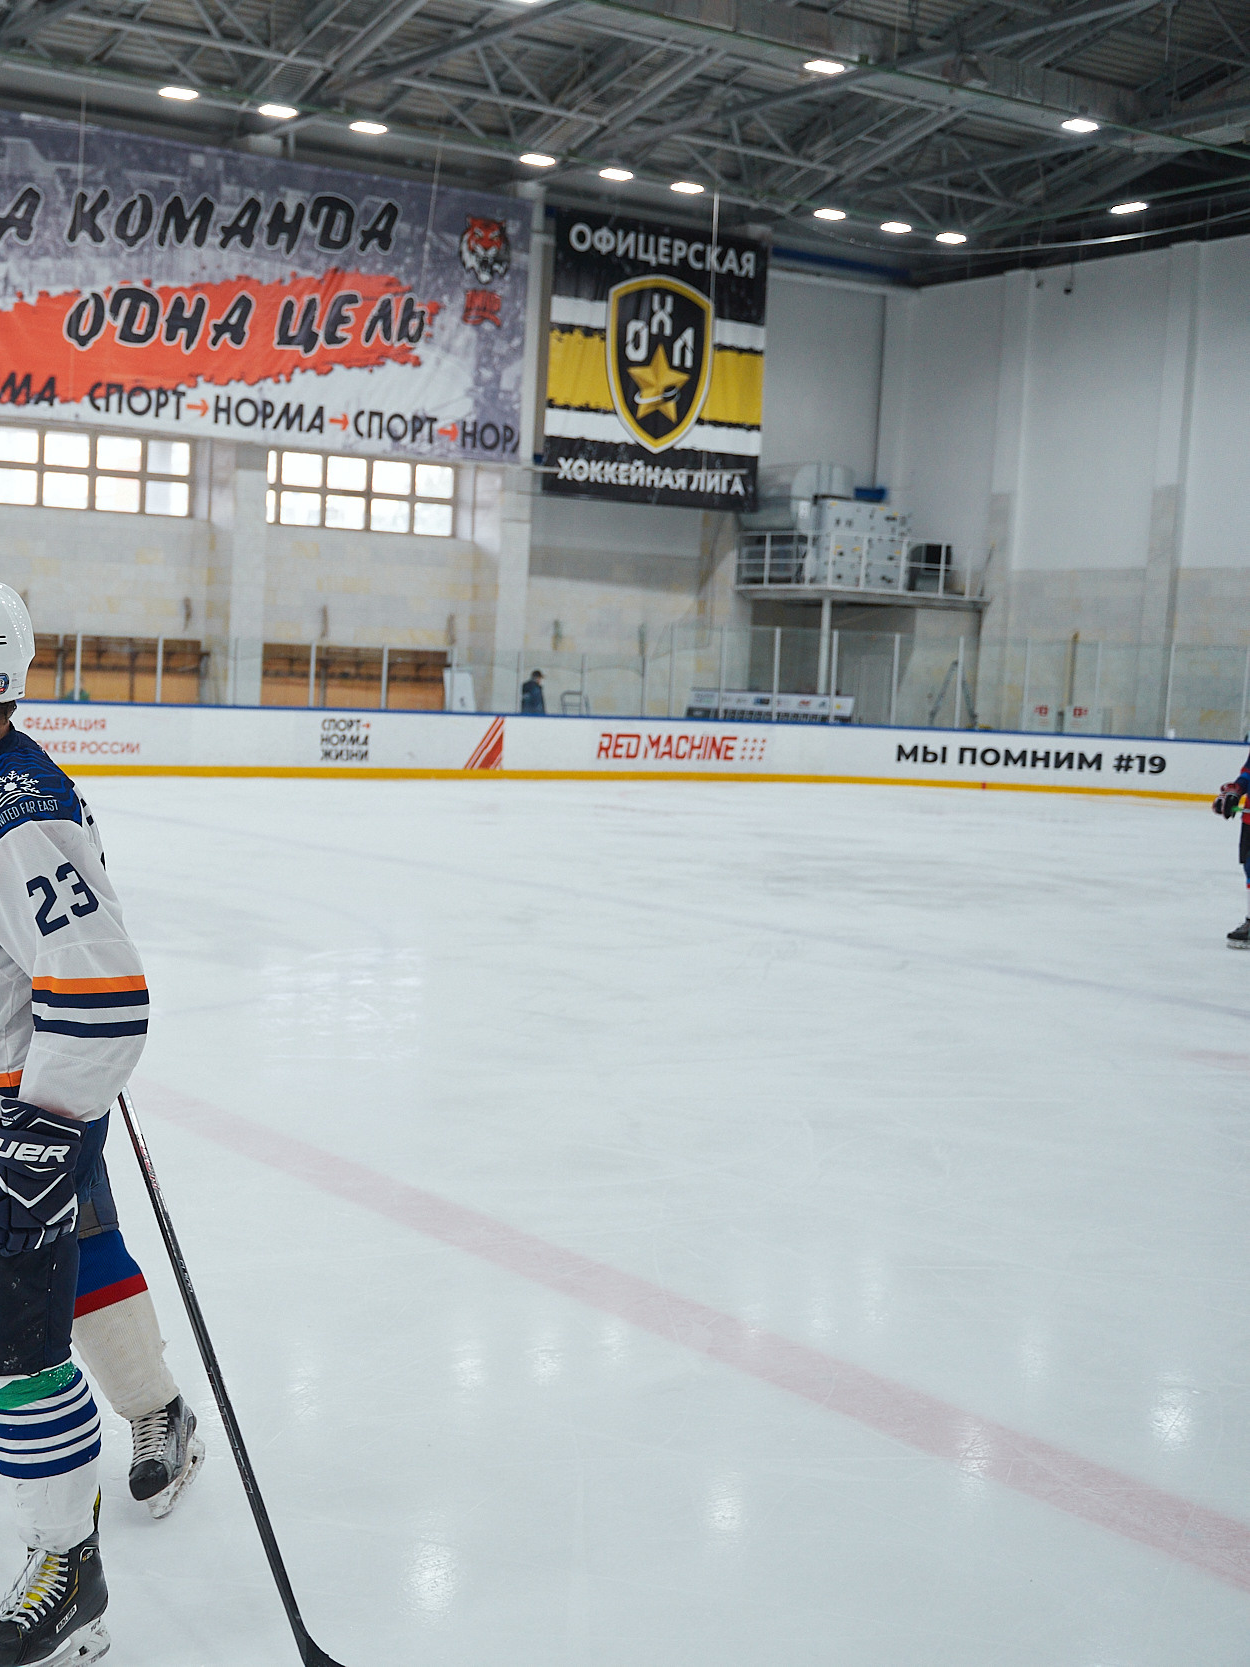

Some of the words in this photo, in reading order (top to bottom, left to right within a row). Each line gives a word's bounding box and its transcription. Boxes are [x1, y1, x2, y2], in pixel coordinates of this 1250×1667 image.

[67, 188, 399, 254] КОМАНДА
[569, 223, 756, 279] ОФИЦЕРСКАЯ
[65, 286, 253, 352] ОДНА
[275, 292, 427, 356] ЦЕЛЬ
[89, 381, 186, 420] СПОРТ
[213, 395, 325, 434] НОРМА
[353, 410, 438, 445] СПОРТ
[556, 457, 687, 490] ХОККЕЙНАЯ
[690, 471, 747, 496] ЛИГА
[23, 717, 106, 731] ФЕДЕРАЦИЯ
[321, 718, 362, 733] СПОРТ
[40, 740, 77, 753] ККЕЯ
[80, 741, 140, 754] РОССИИ
[321, 734, 370, 747] НОРМА
[597, 733, 641, 760] RED
[643, 735, 738, 761] MACHINE
[320, 749, 369, 762] ЖИЗНИ
[896, 744, 947, 764] МЫ
[958, 746, 1103, 771] ПОМНИМ
[1113, 754, 1167, 775] #19
[20, 802, 36, 815] FAR
[38, 799, 59, 813] EAST
[26, 862, 99, 937] 23
